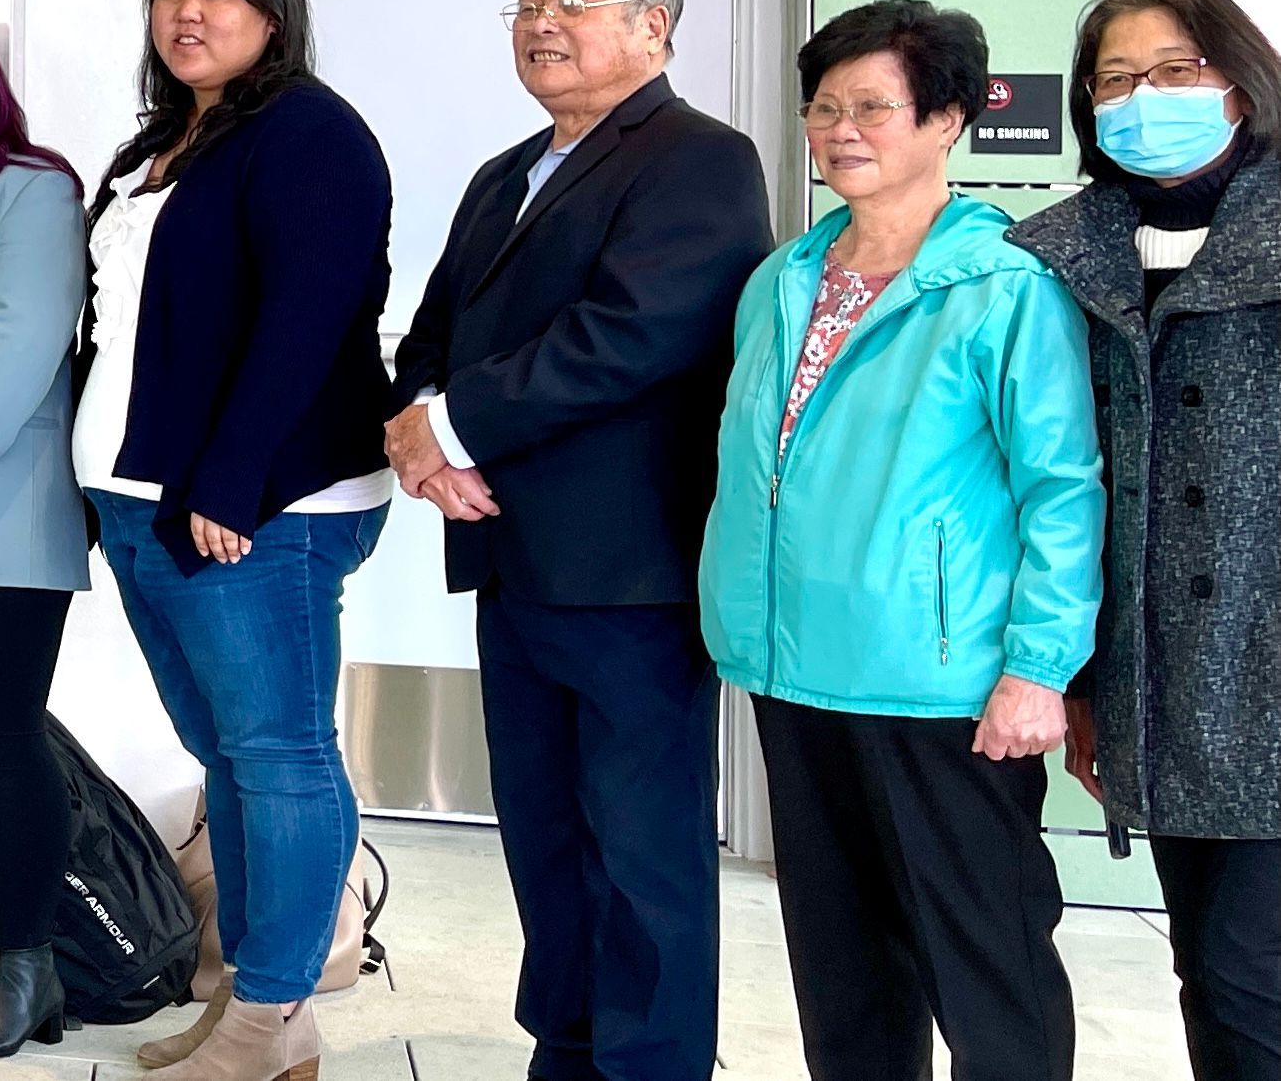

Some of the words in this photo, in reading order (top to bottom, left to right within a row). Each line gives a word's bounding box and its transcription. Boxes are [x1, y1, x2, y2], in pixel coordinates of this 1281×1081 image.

[978, 127, 995, 140] NO
[997, 127, 1050, 140] SMOKING
[85, 896, 135, 955] ARMOUR
